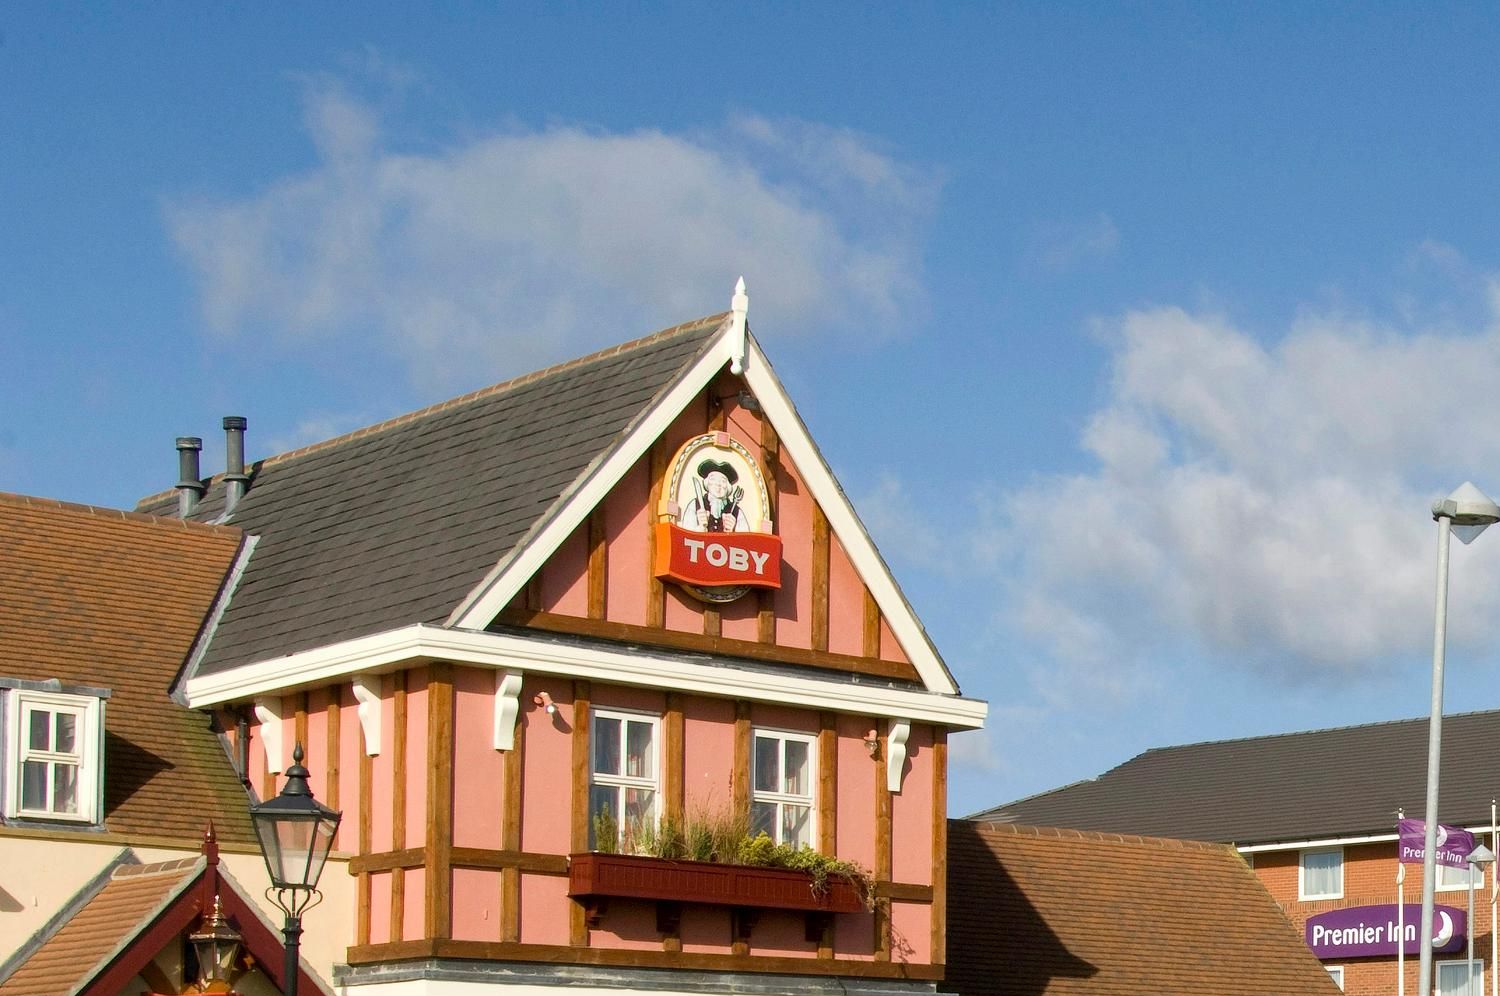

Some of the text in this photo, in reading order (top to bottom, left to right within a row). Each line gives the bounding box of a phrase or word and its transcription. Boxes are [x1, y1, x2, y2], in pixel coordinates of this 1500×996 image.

[684, 537, 770, 575] TOBY
[1403, 847, 1463, 863] Preer Inn
[1312, 922, 1384, 947] Premier
